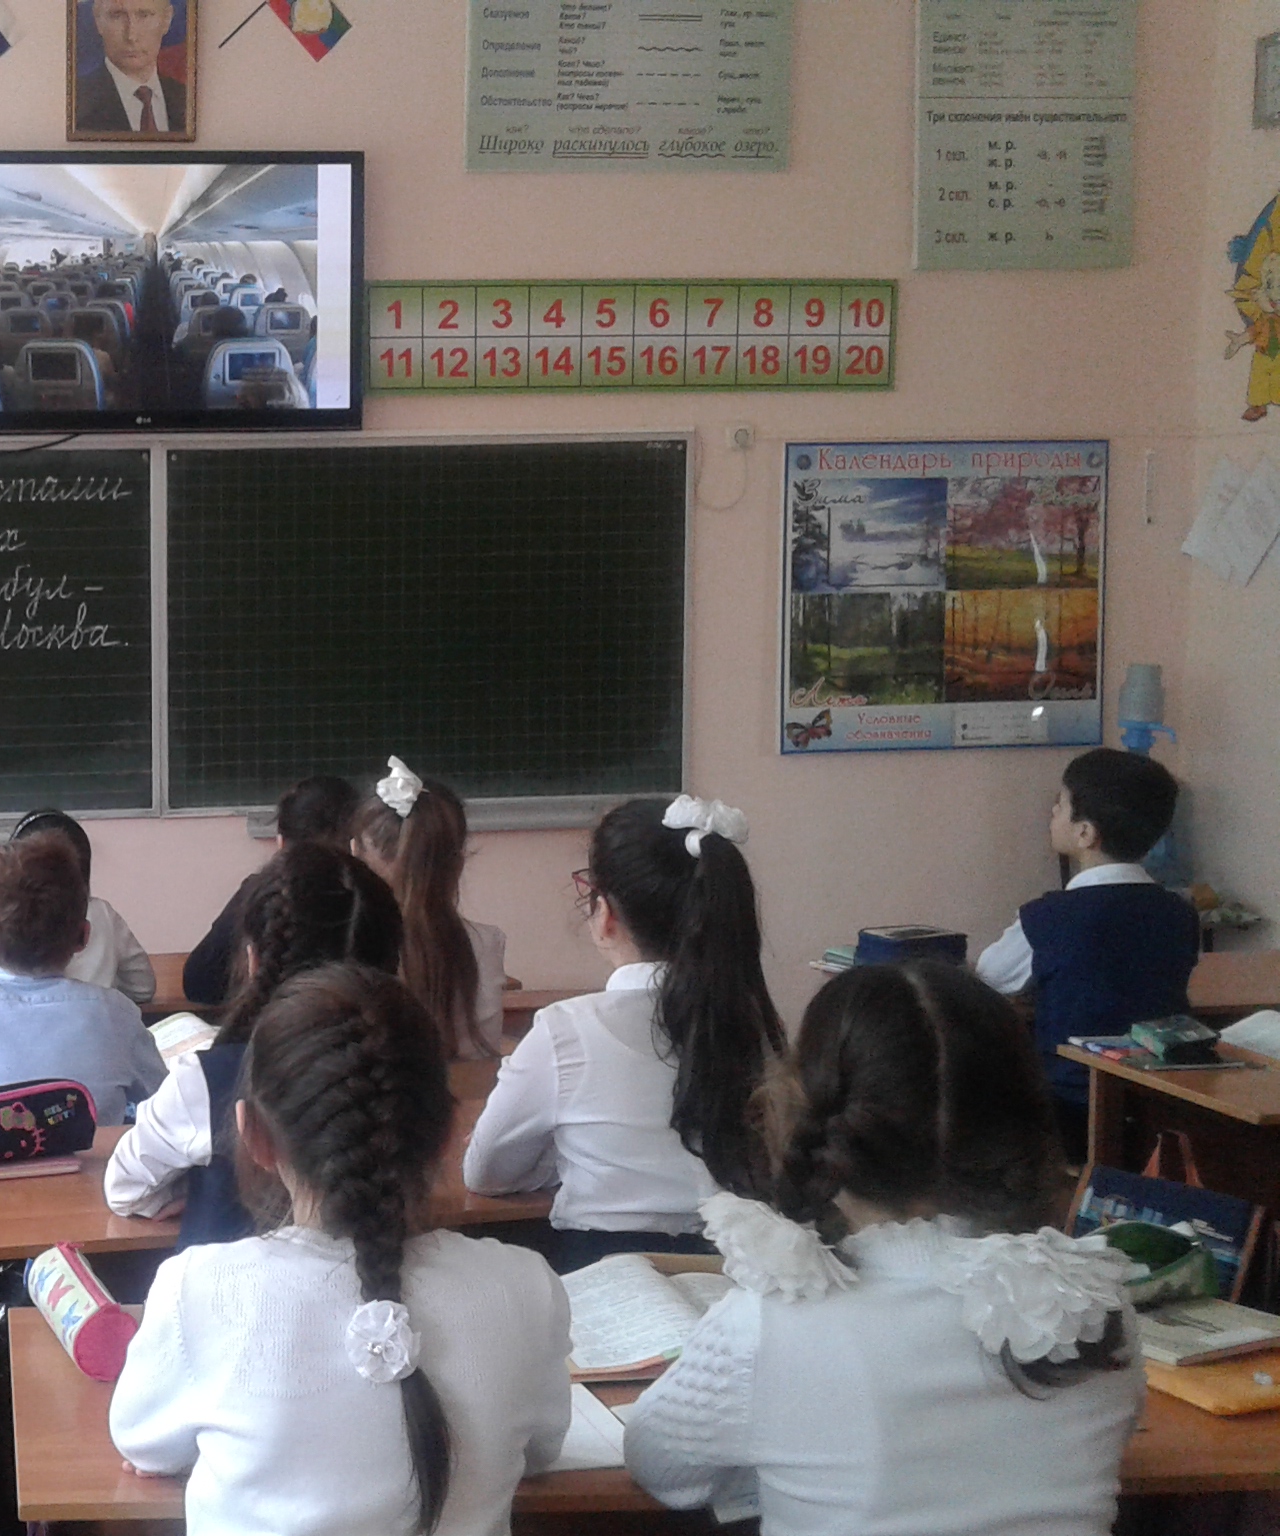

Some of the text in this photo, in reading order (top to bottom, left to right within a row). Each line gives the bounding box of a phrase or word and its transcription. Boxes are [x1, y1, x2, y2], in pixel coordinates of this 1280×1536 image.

[479, 135, 779, 157] Широко раскинулось глубокое озеро.
[387, 298, 885, 329] 1 2 3 4 5 6 7 8 9 10
[380, 345, 884, 378] 11 12 13 14 15 16 17 18 19 20
[819, 448, 1082, 476] Календарь природы
